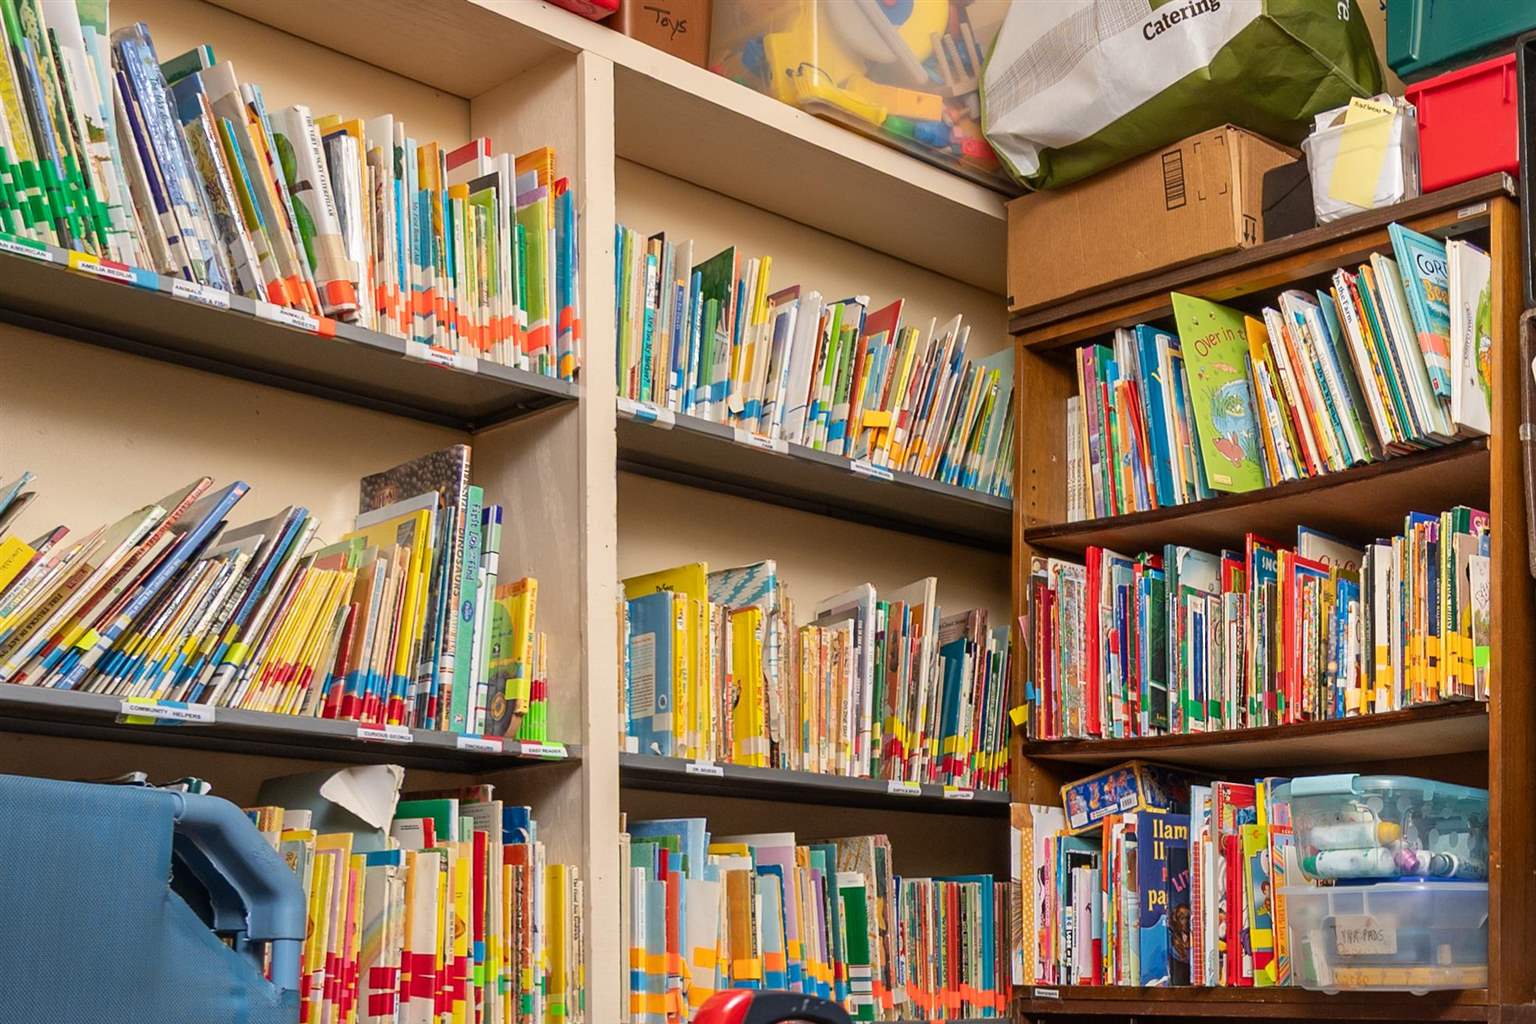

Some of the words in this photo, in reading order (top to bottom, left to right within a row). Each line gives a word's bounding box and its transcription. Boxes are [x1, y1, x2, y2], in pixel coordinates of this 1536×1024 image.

[643, 5, 688, 40] Toys
[1142, 0, 1221, 41] Catering
[1194, 331, 1223, 358] Over
[1224, 328, 1237, 342] in
[470, 503, 481, 528] First
[28, 606, 51, 629] TRUCKS
[130, 705, 169, 718] COMMUNITY
[172, 711, 203, 721] HELPERS
[364, 730, 390, 739] CURIOUS
[390, 733, 412, 741] GEORGE
